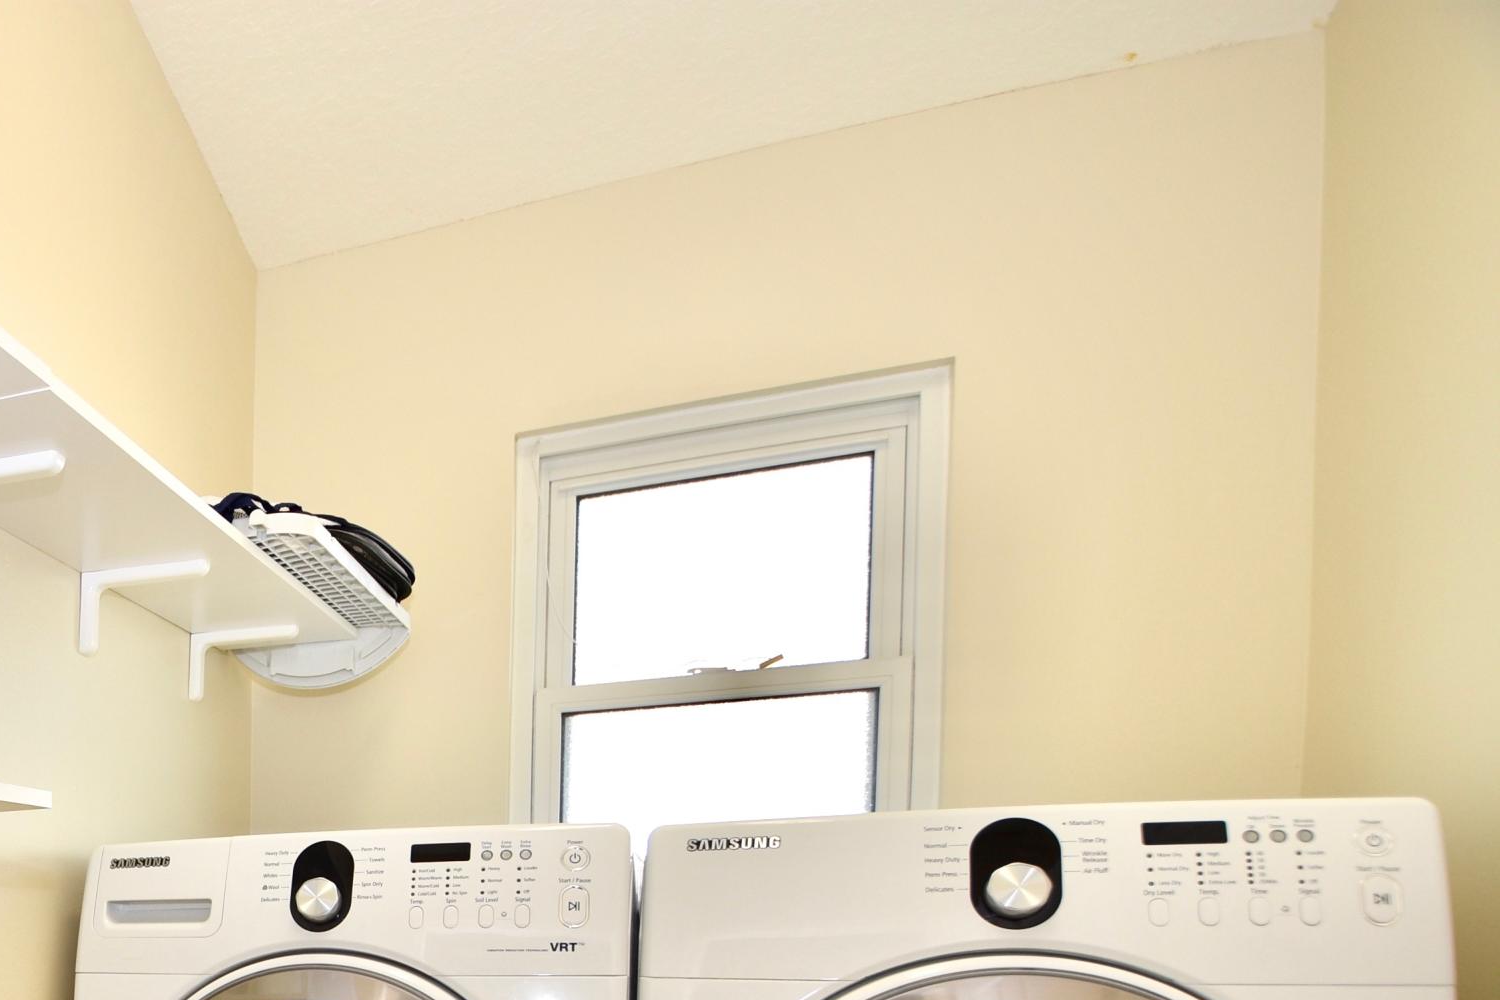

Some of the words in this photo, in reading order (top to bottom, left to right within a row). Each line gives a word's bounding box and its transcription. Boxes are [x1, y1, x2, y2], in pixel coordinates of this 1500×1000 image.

[687, 836, 781, 852] SAMSUNG
[110, 856, 170, 869] SAMSUNG
[549, 942, 578, 952] VRT
